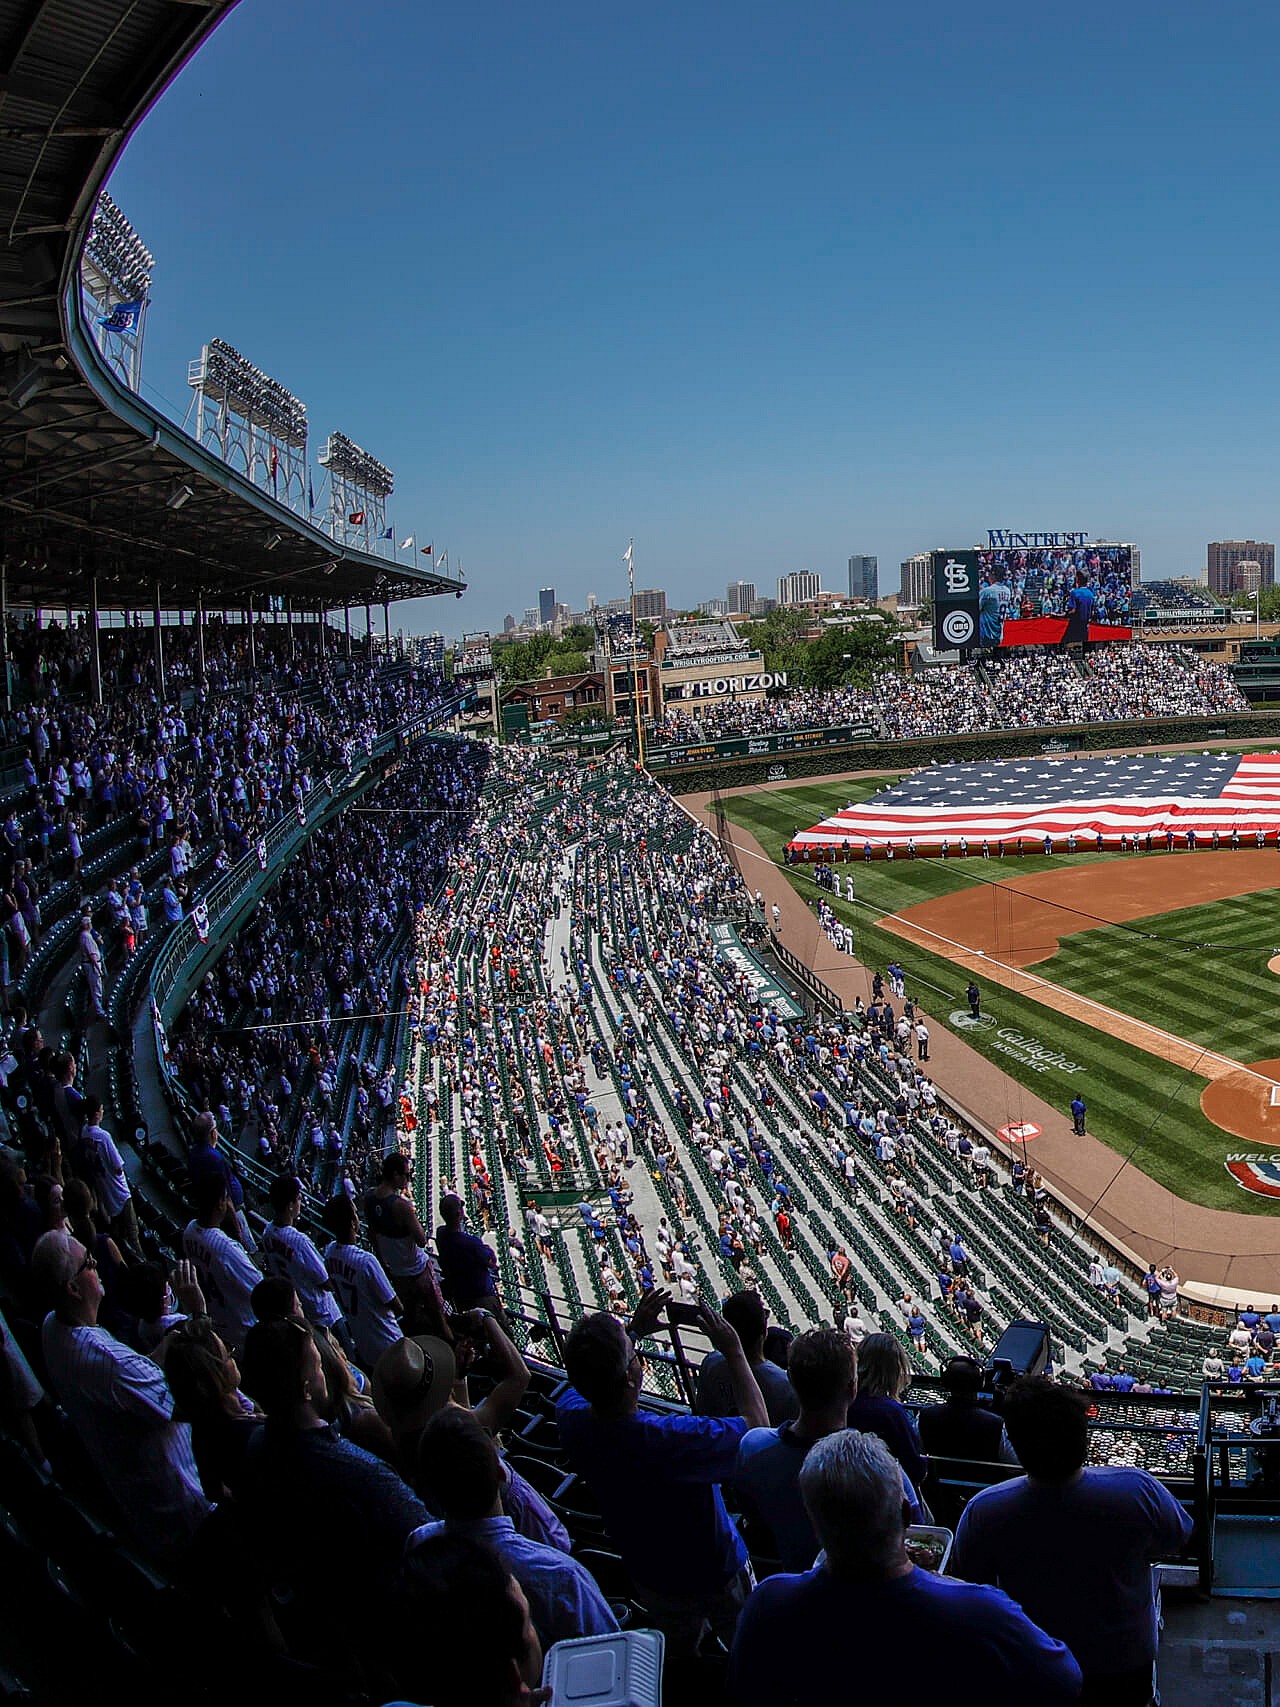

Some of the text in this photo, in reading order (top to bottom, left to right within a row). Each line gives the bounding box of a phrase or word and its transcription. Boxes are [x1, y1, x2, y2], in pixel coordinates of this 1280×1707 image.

[986, 529, 1089, 547] WINTRUST
[700, 671, 788, 696] HORIZON
[1041, 743, 1069, 751] Gallagher
[990, 1041, 1051, 1073] INSURANCE
[996, 1027, 1088, 1074] Gallagher
